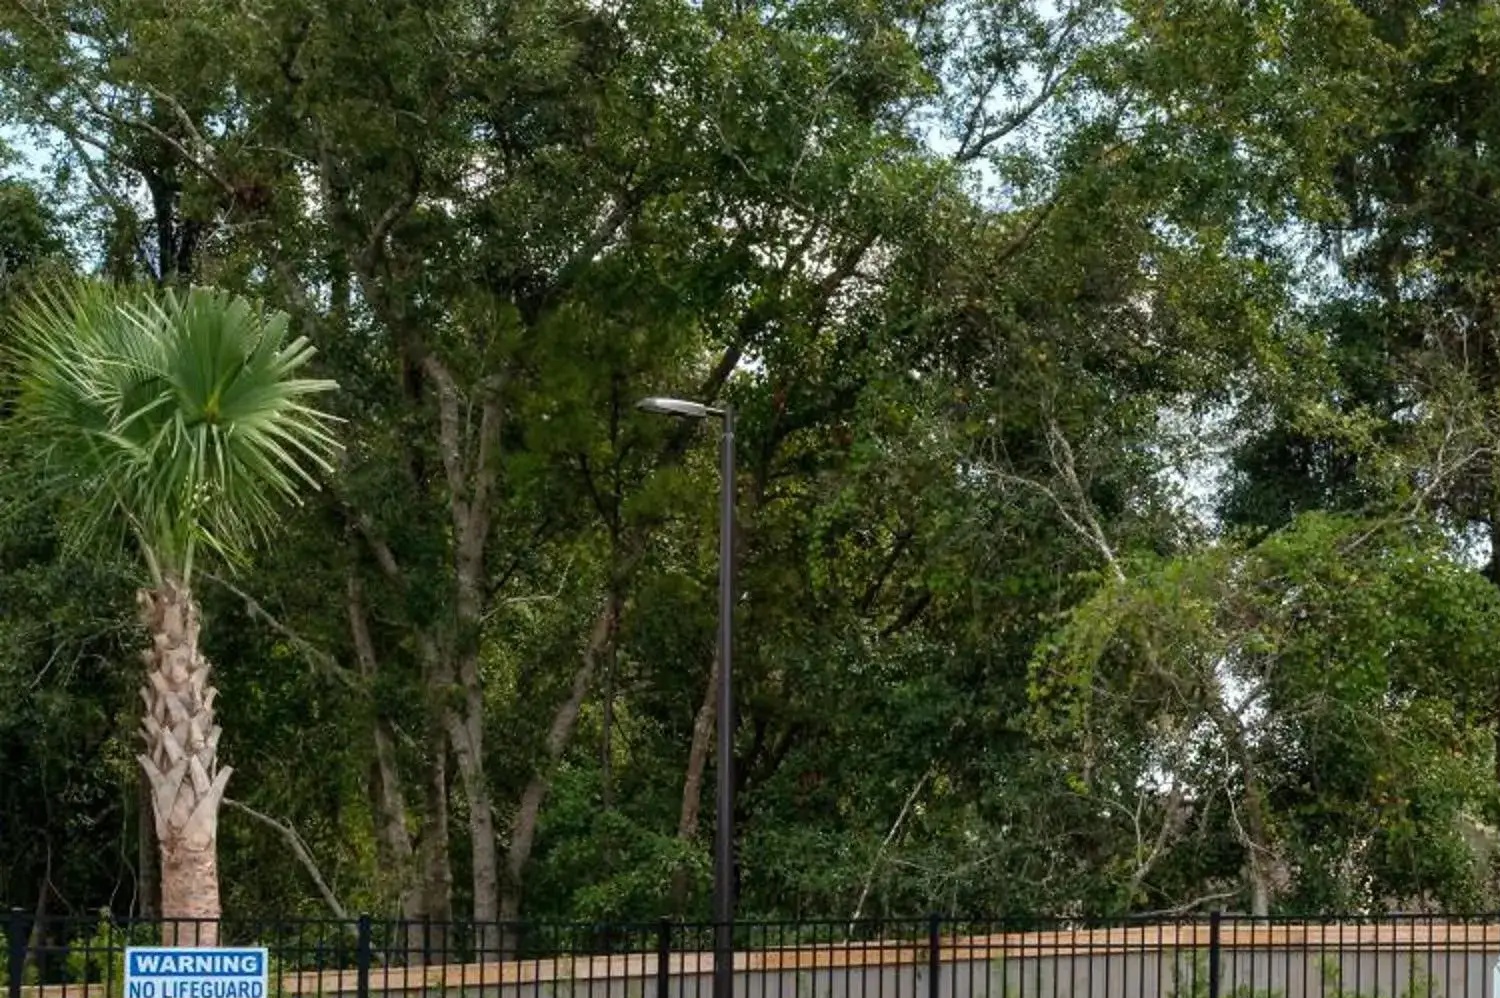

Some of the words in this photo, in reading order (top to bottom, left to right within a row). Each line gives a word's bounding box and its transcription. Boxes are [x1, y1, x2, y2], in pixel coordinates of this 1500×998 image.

[136, 955, 258, 973] WARNING
[130, 981, 155, 998] NO
[162, 981, 262, 998] LIFEGUARD
